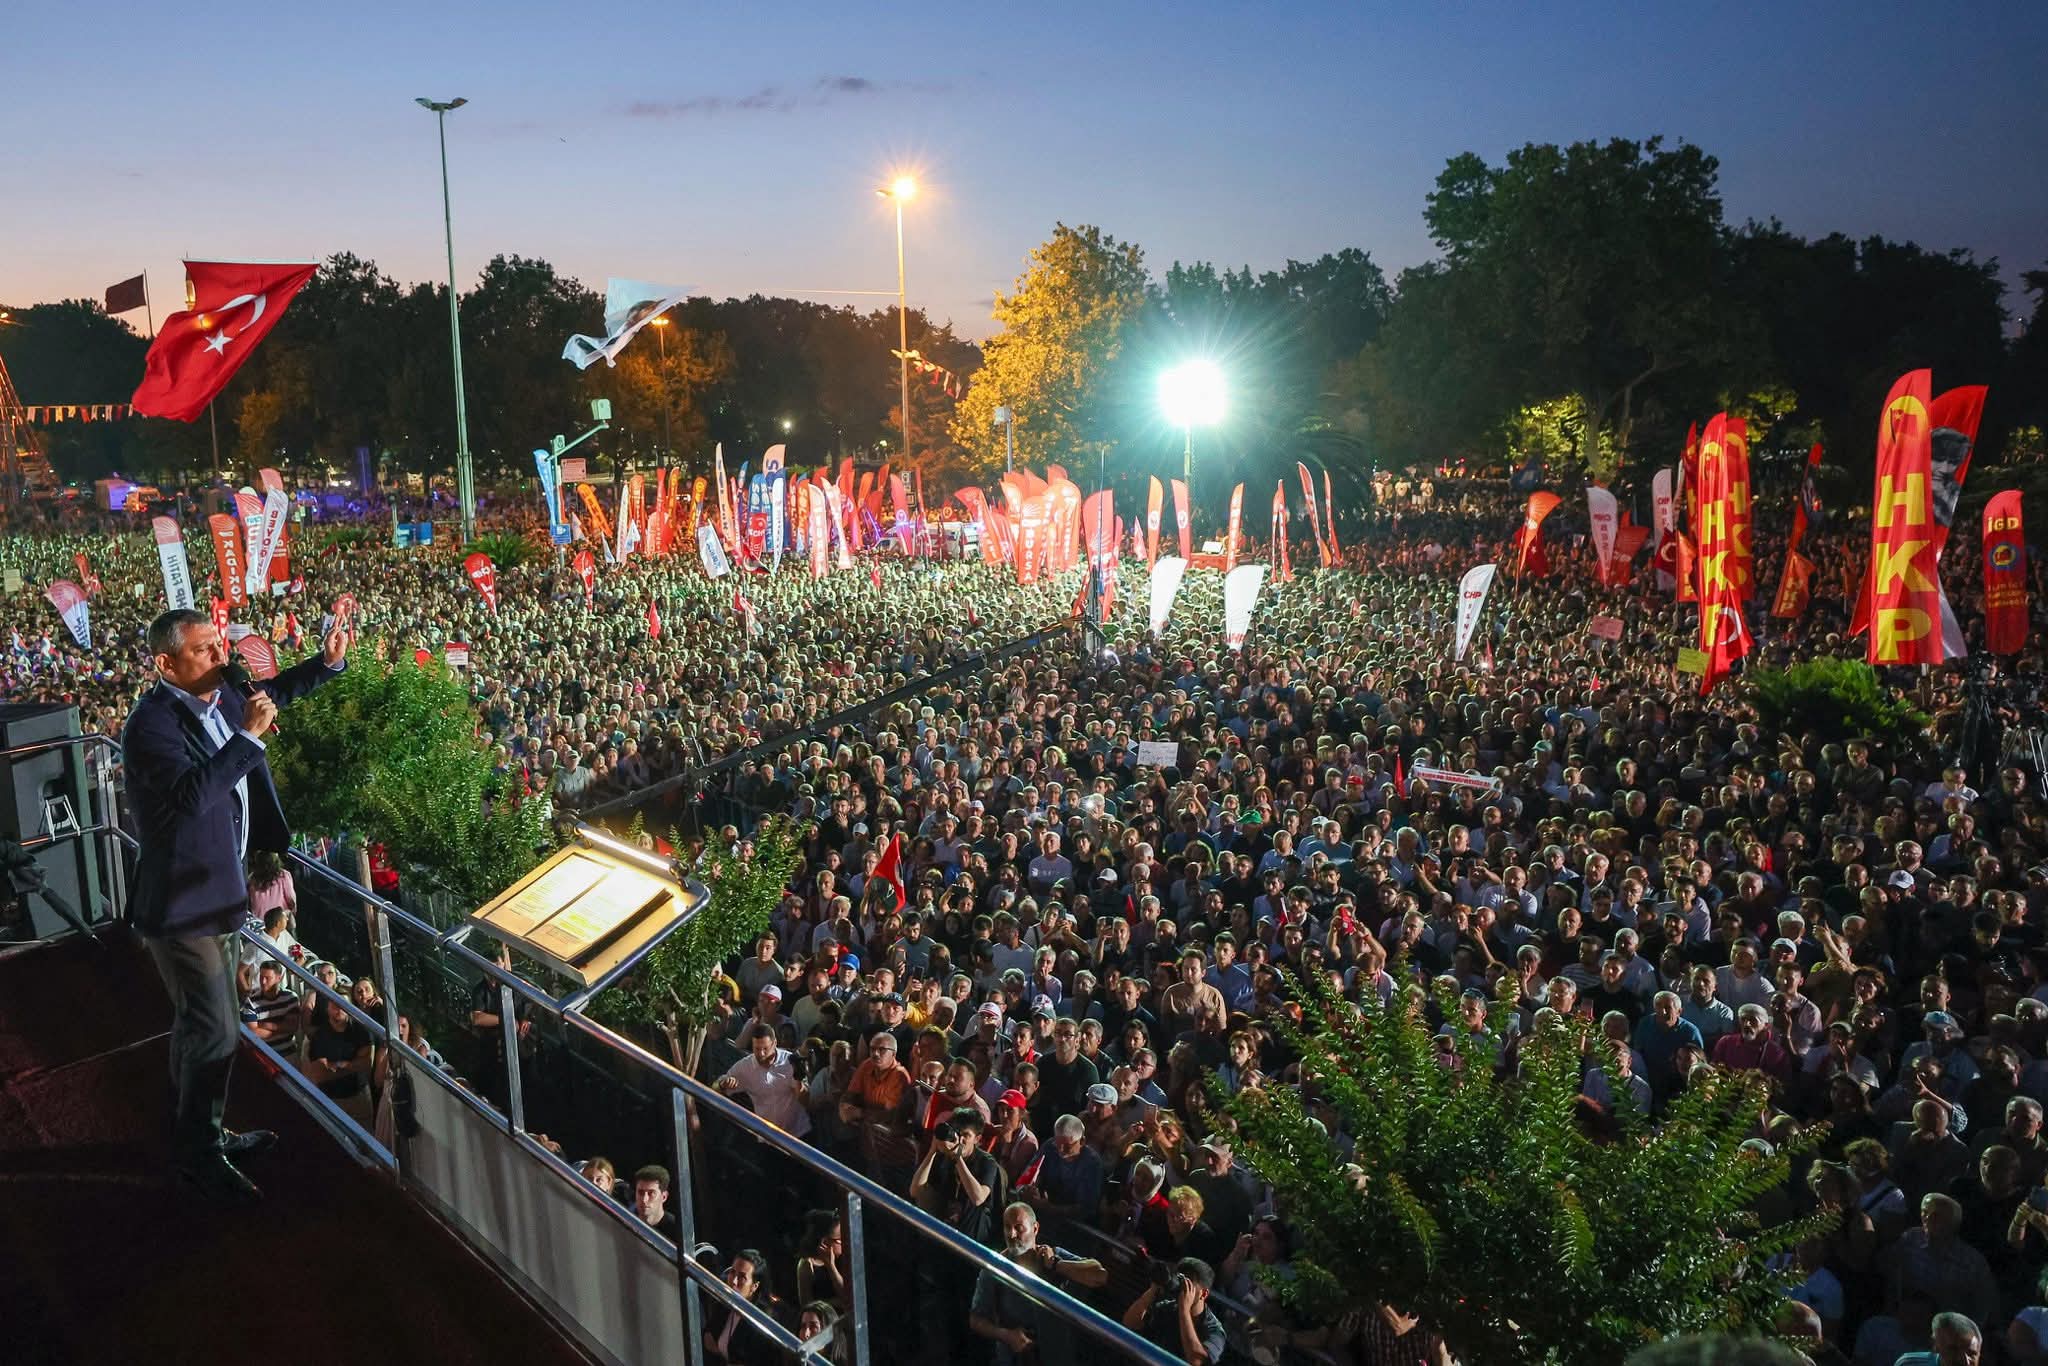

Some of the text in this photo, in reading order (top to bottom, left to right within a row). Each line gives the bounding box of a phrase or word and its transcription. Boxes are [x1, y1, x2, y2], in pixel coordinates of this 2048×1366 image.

[1024, 528, 1035, 581] BURSA
[1876, 472, 1937, 662] HKP
[1463, 591, 1482, 599] CHP
